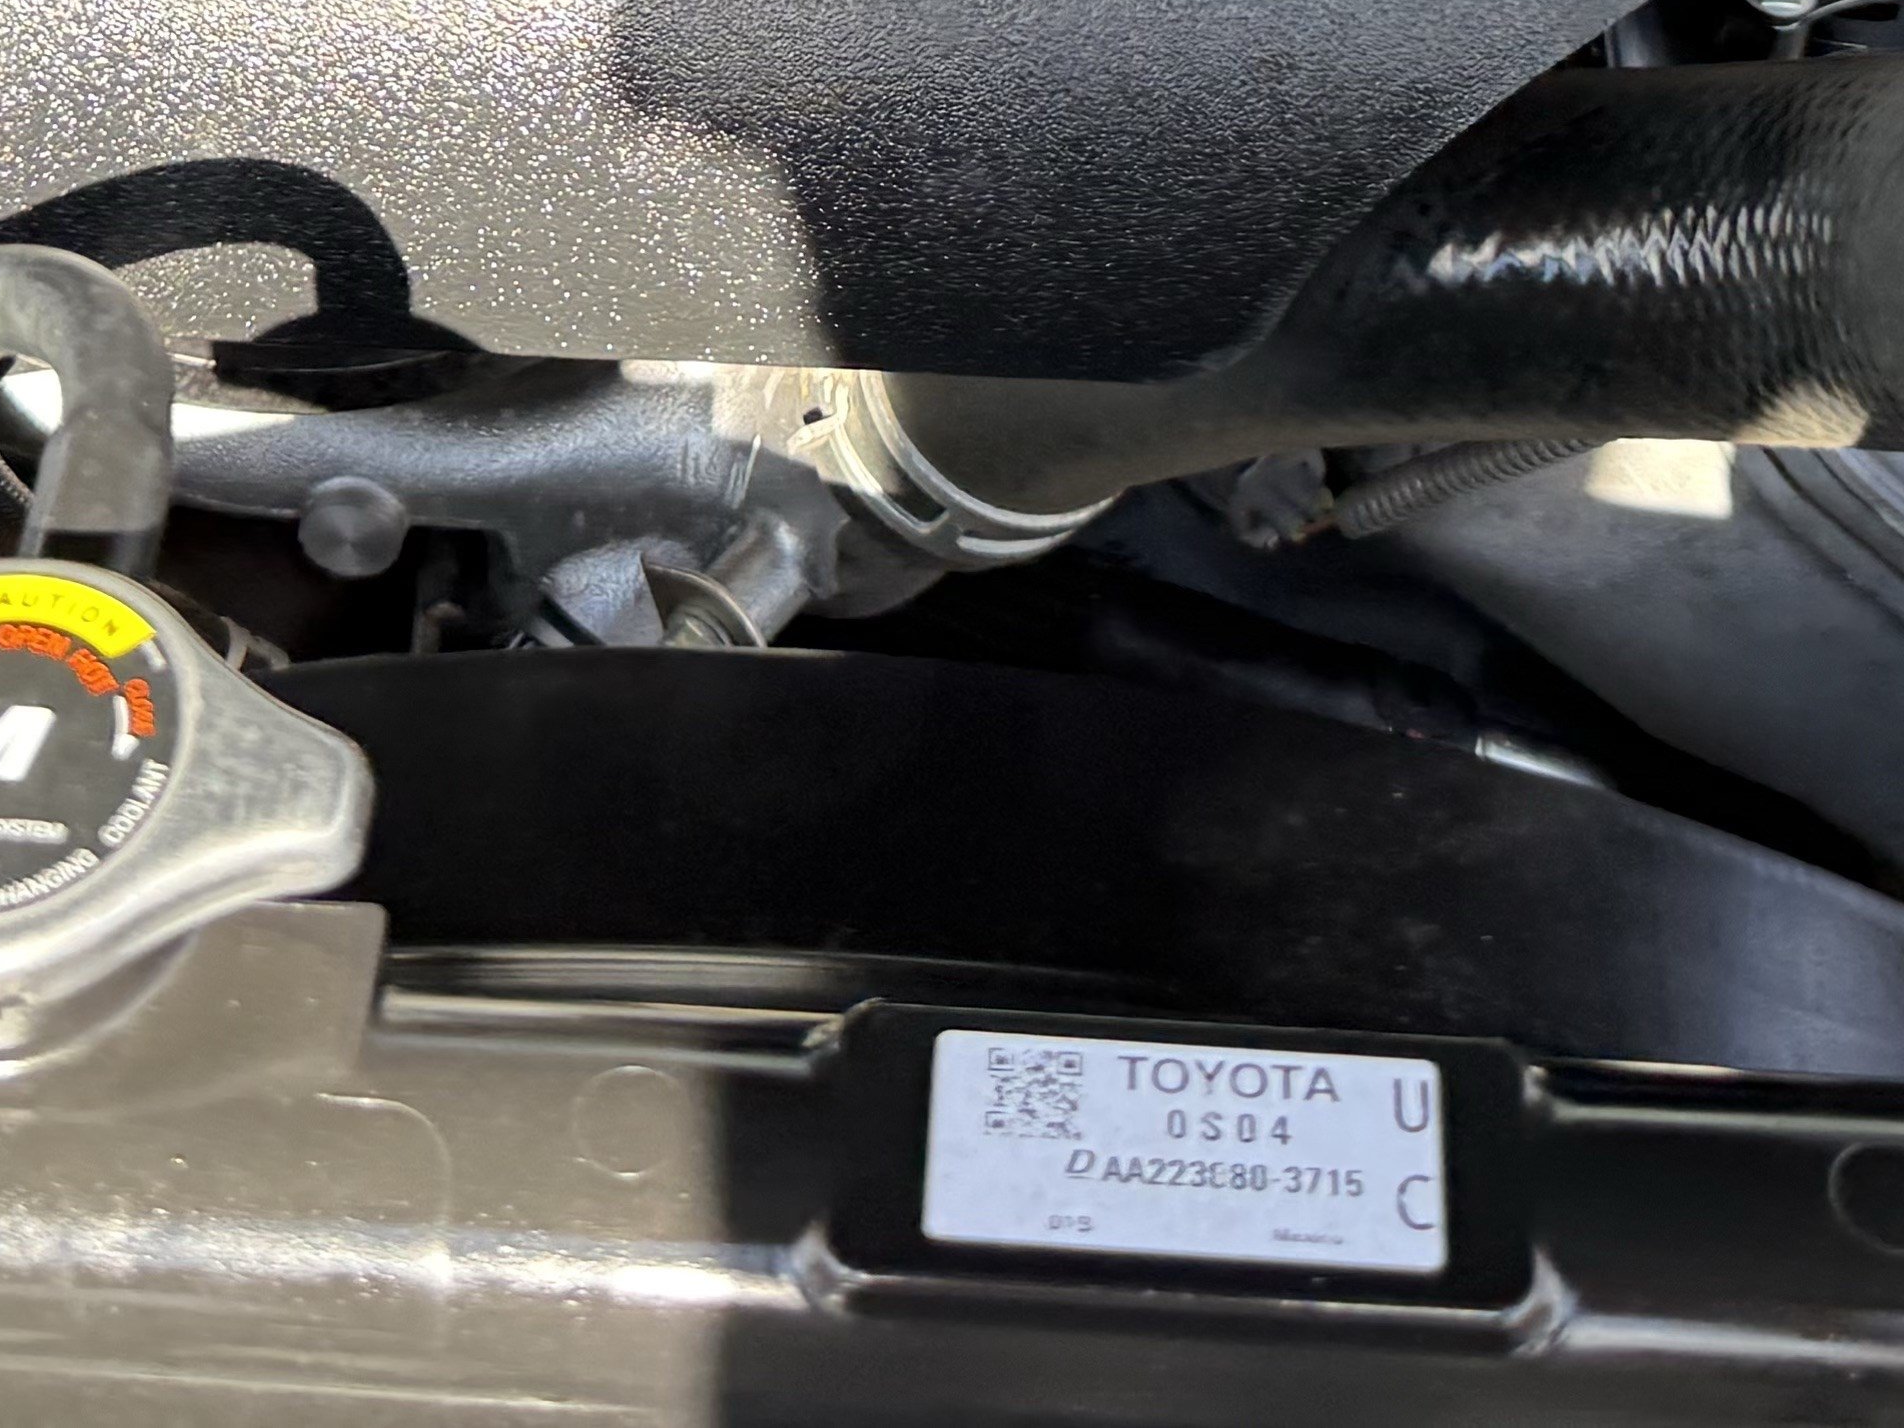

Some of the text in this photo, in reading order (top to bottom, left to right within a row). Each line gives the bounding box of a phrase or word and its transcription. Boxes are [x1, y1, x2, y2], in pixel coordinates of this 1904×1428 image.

[96, 758, 171, 847] COOLANT
[1117, 1055, 1341, 1102] TOYOTA
[1393, 1077, 1431, 1134] U
[1397, 1173, 1437, 1231] C
